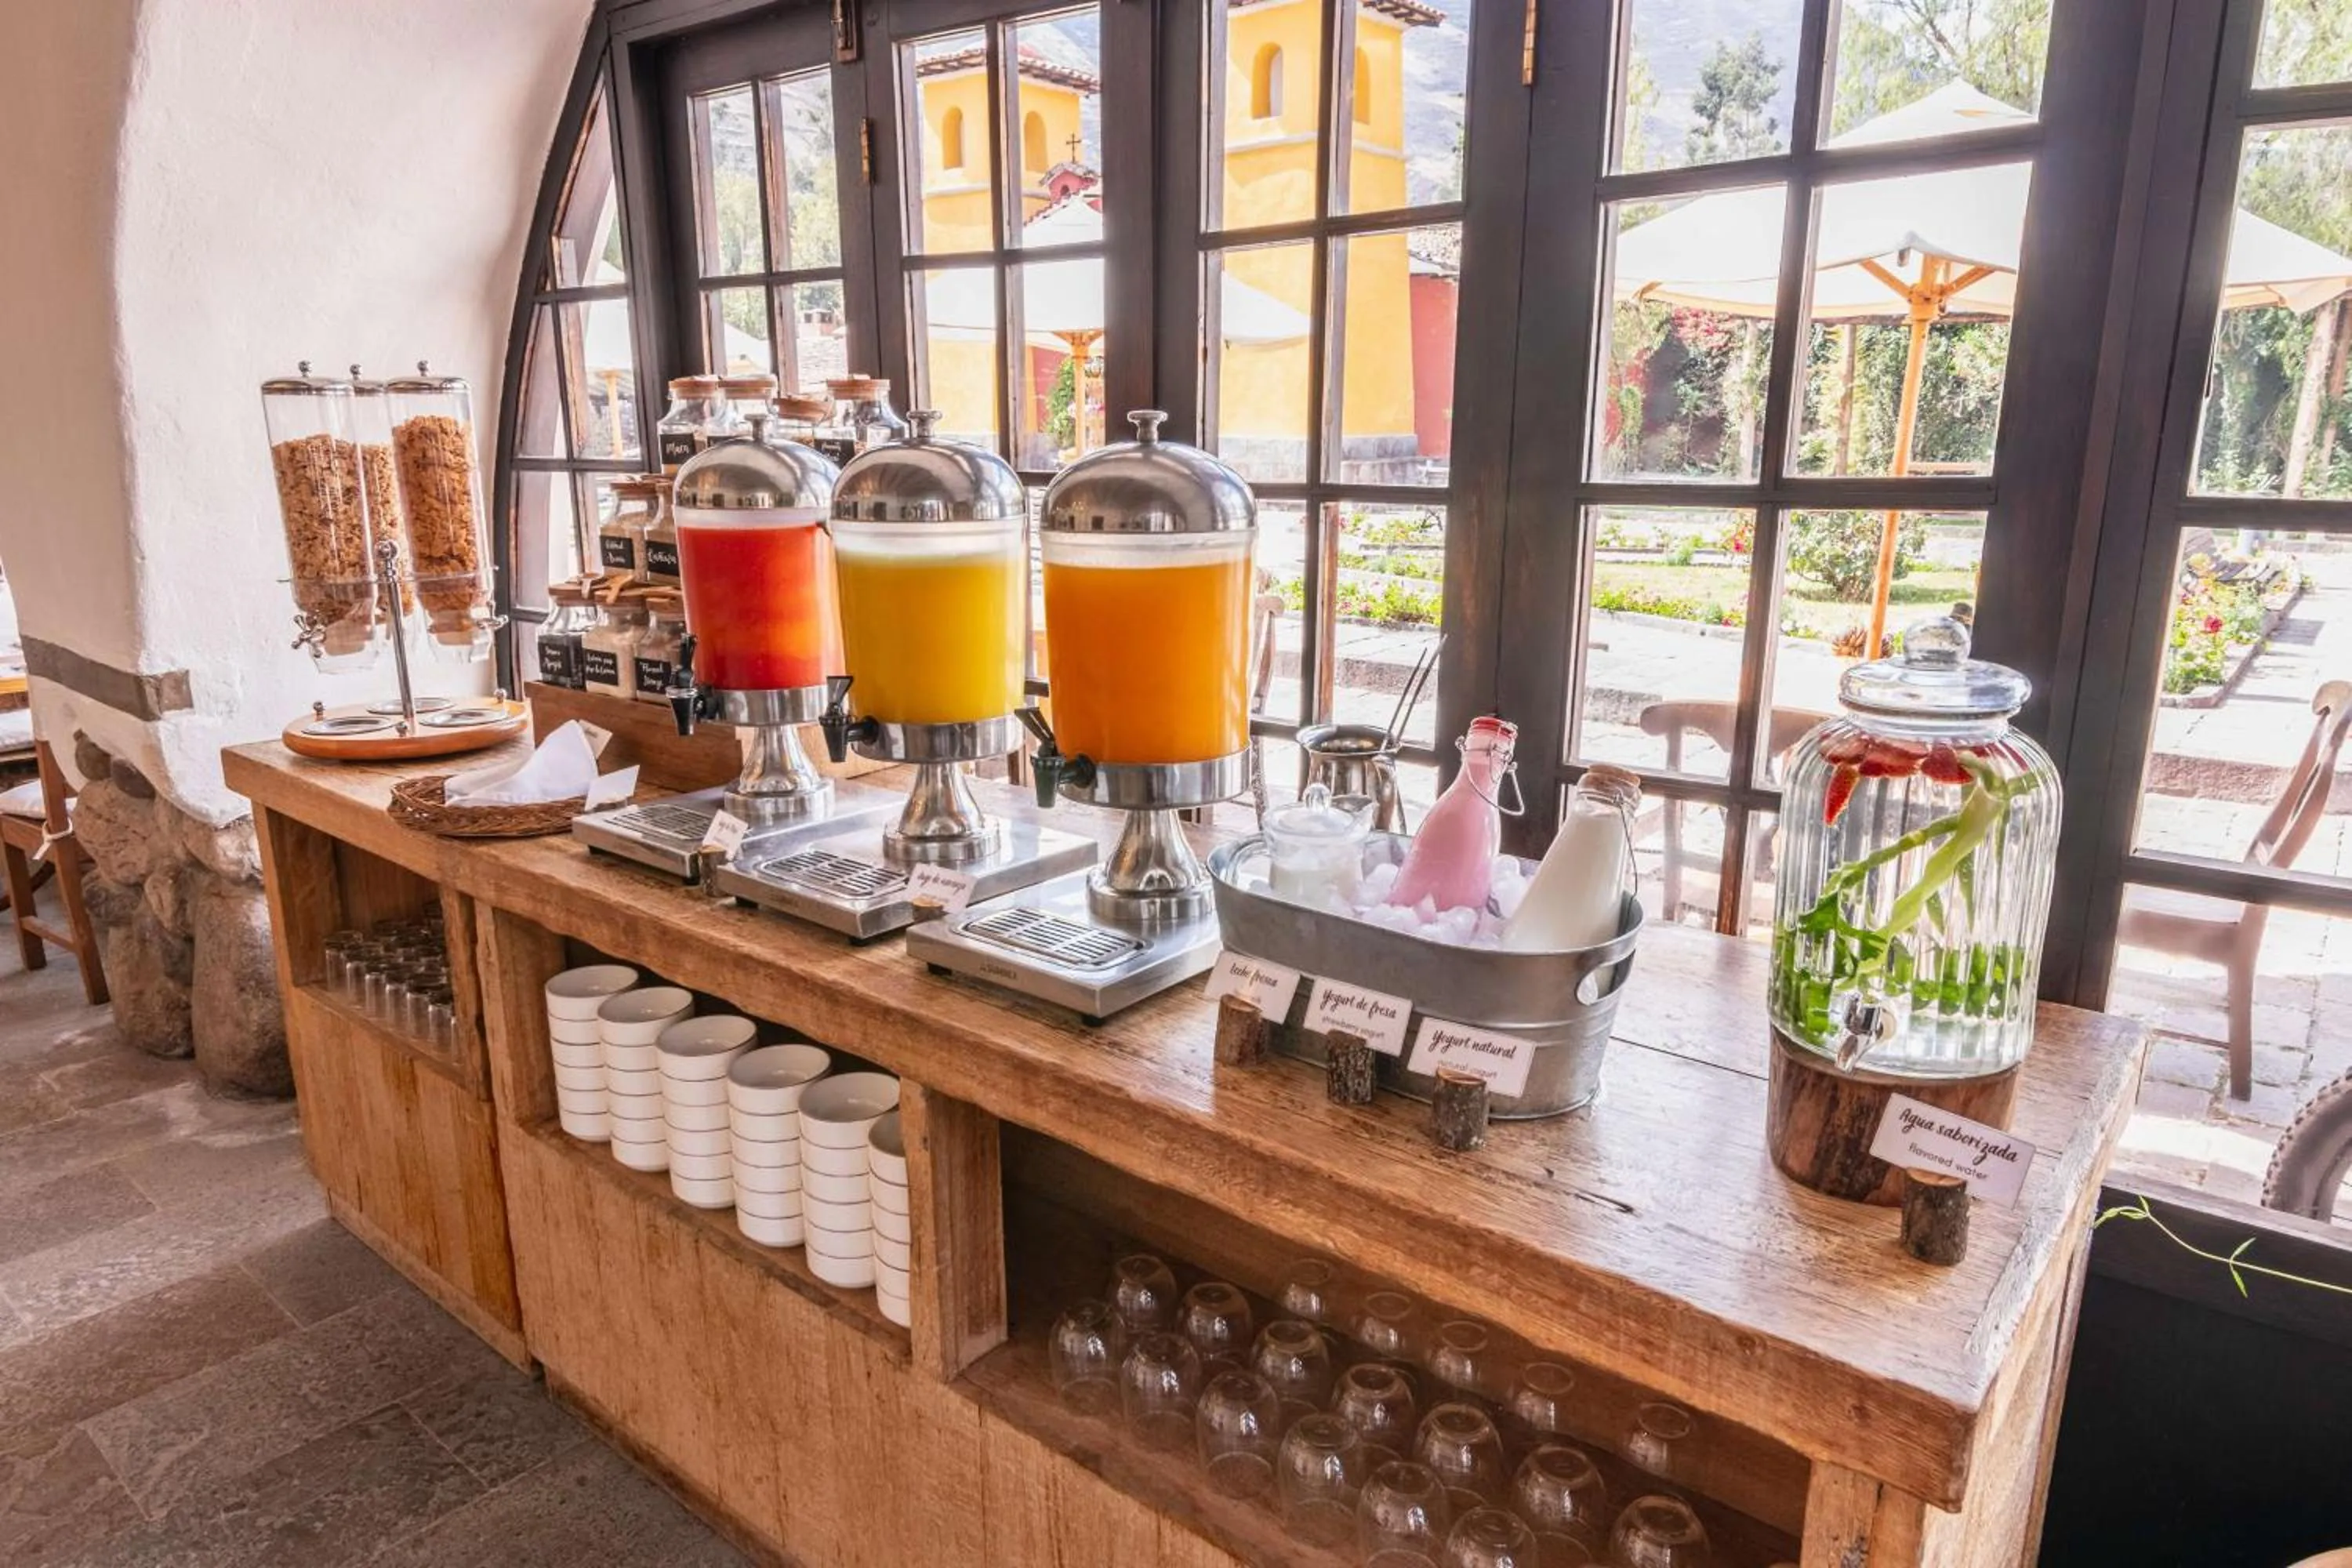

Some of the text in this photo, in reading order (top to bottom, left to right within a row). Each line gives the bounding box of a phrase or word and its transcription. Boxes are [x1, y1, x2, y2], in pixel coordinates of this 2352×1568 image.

[1319, 989, 1396, 1019] Yogurt de fresa
[1428, 1029, 1517, 1058] Yogurt natural
[1899, 1108, 2019, 1166] Agua saborizada
[1908, 1142, 1990, 1179] flavored water
